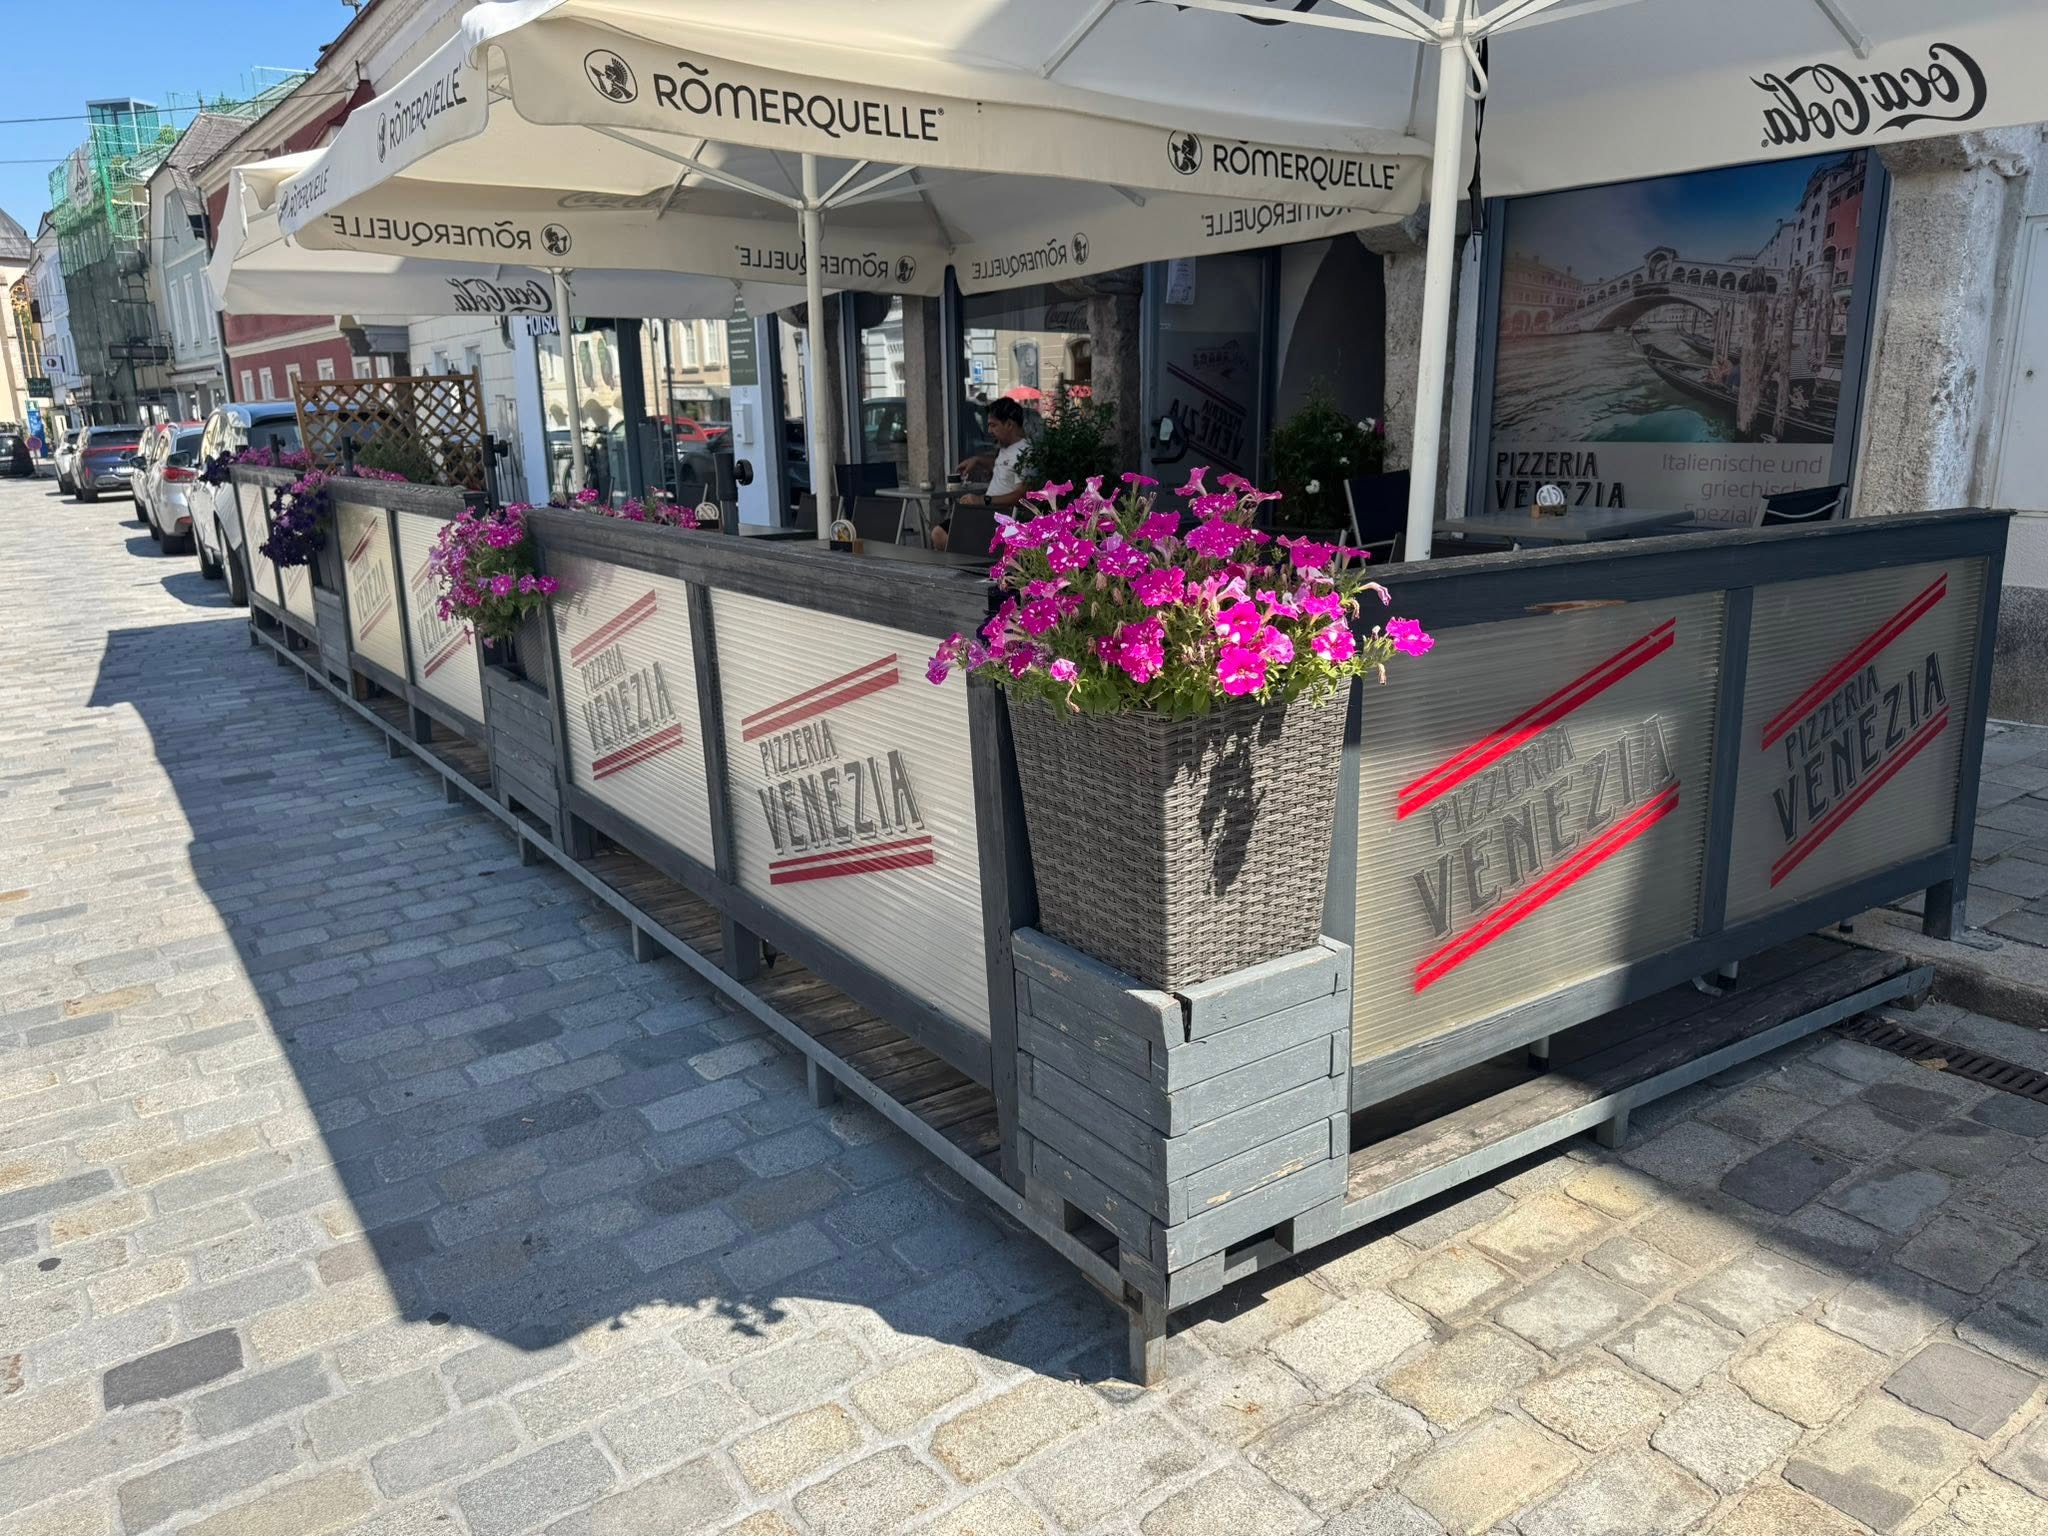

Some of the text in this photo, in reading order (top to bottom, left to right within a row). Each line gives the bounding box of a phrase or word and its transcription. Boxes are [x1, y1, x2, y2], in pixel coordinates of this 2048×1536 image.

[1496, 452, 1599, 479] PIZZERIA
[1662, 453, 1823, 475] Italienische und
[581, 660, 677, 756] VENEZIA
[758, 718, 840, 780] PIZZERIA
[1772, 651, 1947, 846] VENEZIA
[1784, 665, 1881, 772] PIZZERIA
[756, 749, 926, 856] VENEZIA
[1412, 713, 1676, 942] VENEZIA
[1430, 724, 1577, 848] PIZZERIA
